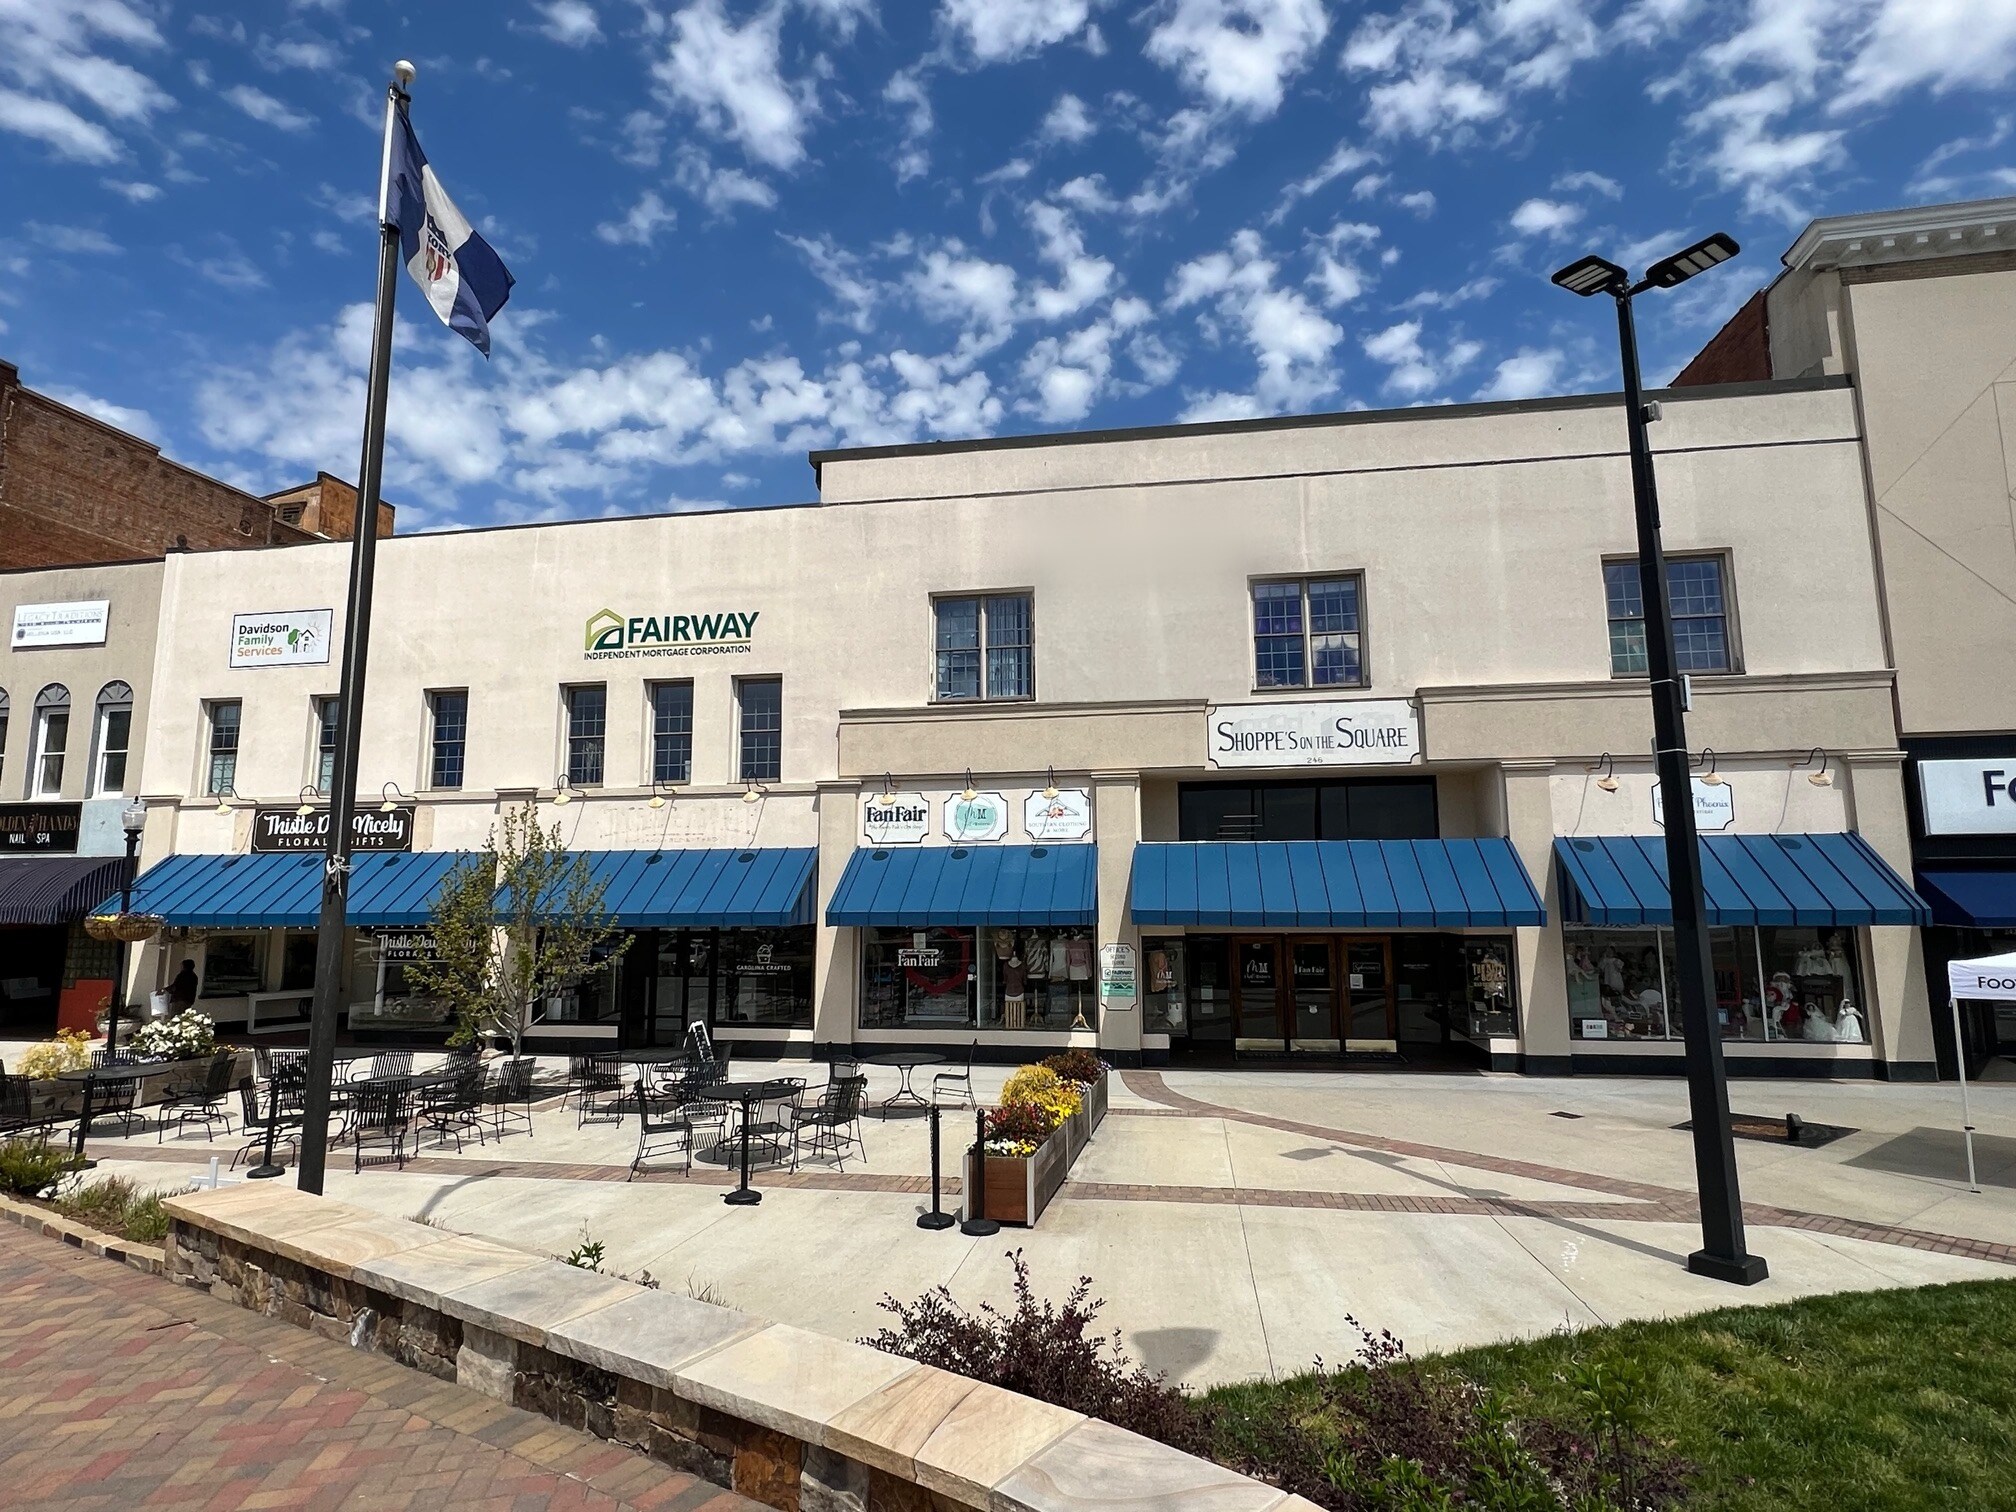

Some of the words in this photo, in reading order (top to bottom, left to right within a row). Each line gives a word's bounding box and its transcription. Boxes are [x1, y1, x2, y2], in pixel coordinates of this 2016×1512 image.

[239, 623, 290, 635] Davidson
[627, 611, 760, 643] FAIRWAY
[238, 634, 275, 646] Family
[237, 646, 283, 657] Services
[584, 649, 641, 661] INDEPENDENT
[642, 647, 689, 658] MORTGAGE
[690, 645, 751, 656] CORPORATION
[1217, 721, 1298, 752] SHOPPE'S
[1300, 736, 1313, 749] ON
[1315, 735, 1335, 750] THE
[1336, 717, 1409, 749] SQUARE
[1306, 756, 1324, 764] 246
[264, 814, 316, 836] Thistle
[352, 813, 404, 840] Nicely
[9, 832, 26, 844] NAIL
[36, 832, 51, 844] SPA
[278, 837, 328, 847] FLORAL
[351, 836, 384, 846] IFTS
[376, 933, 412, 949] Thistle
[1977, 976, 2016, 990] FOO
